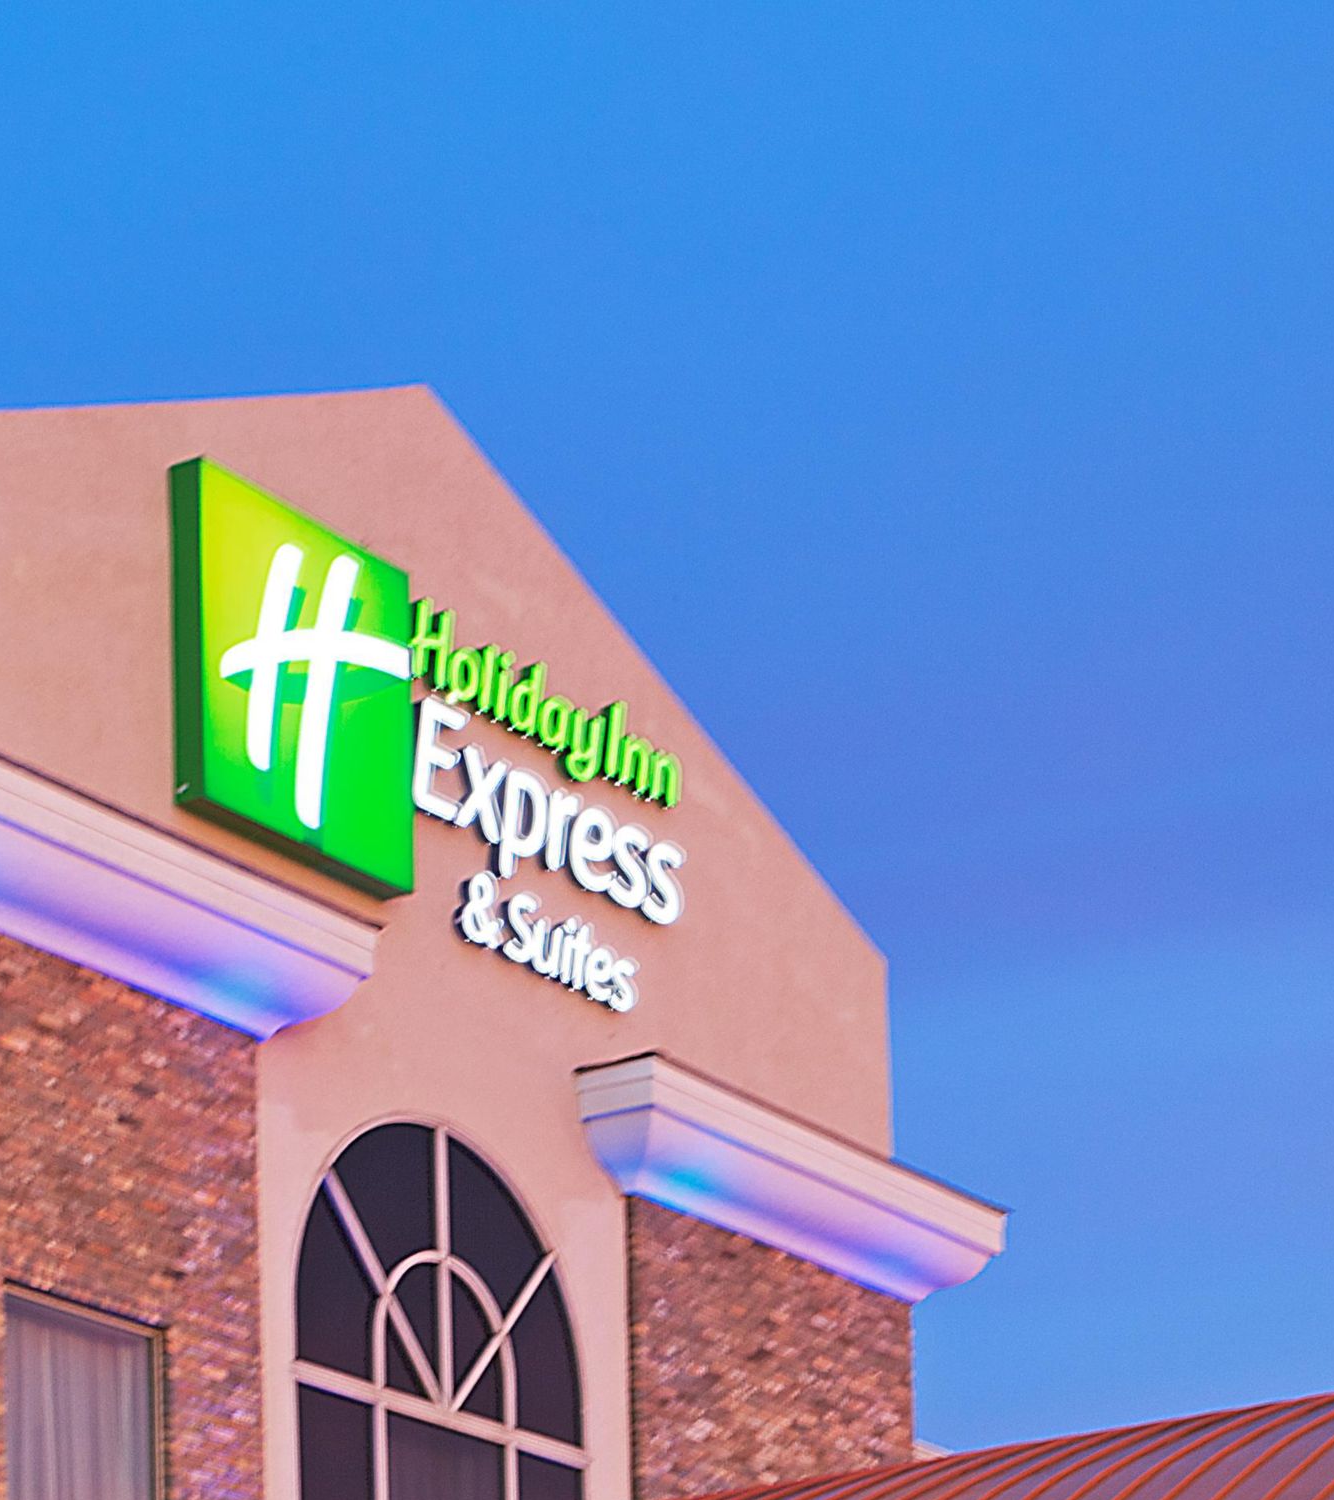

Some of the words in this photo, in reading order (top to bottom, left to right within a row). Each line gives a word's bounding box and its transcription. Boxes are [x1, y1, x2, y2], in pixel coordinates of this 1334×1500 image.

[411, 695, 687, 925] Express
[461, 871, 504, 950] &
[503, 893, 641, 1013] Suites
